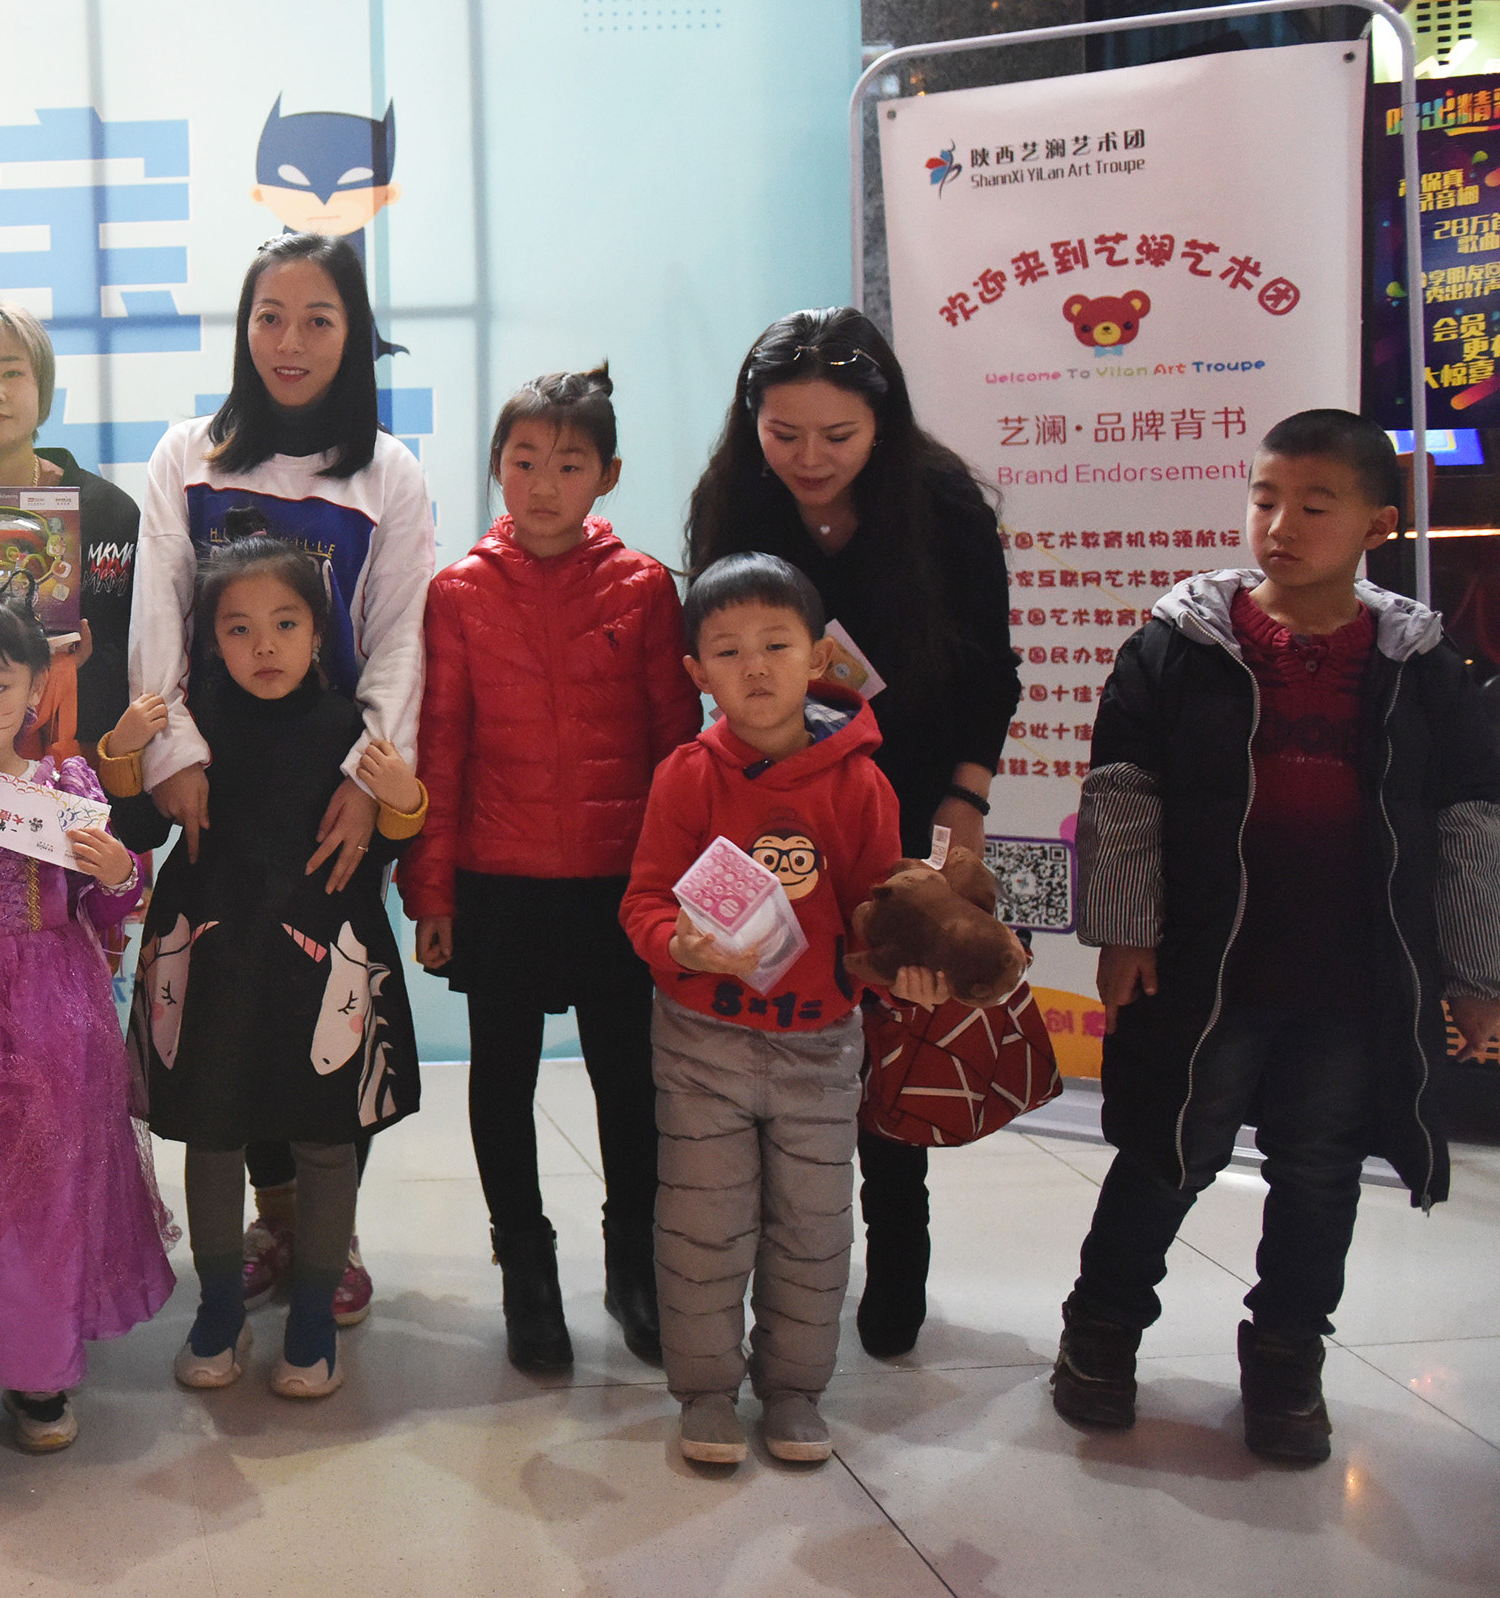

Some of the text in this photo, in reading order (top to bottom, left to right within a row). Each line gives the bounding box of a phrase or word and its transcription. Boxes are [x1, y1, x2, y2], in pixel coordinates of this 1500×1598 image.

[969, 128, 1146, 168] 陕西艺澜艺术团
[970, 168, 1024, 189] ShannXi
[1068, 163, 1091, 177] Art
[1095, 157, 1146, 175] Troupe
[938, 231, 1302, 328] 欢迎来到艺澜艺术团
[1432, 313, 1487, 343] 会员
[984, 370, 1062, 385] Welcome
[1067, 368, 1091, 380] To
[1153, 362, 1187, 375] Art
[1192, 359, 1266, 374] Troupe
[996, 406, 1248, 447] 艺澜·品牌背书
[997, 459, 1248, 487] Brand Endorsement
